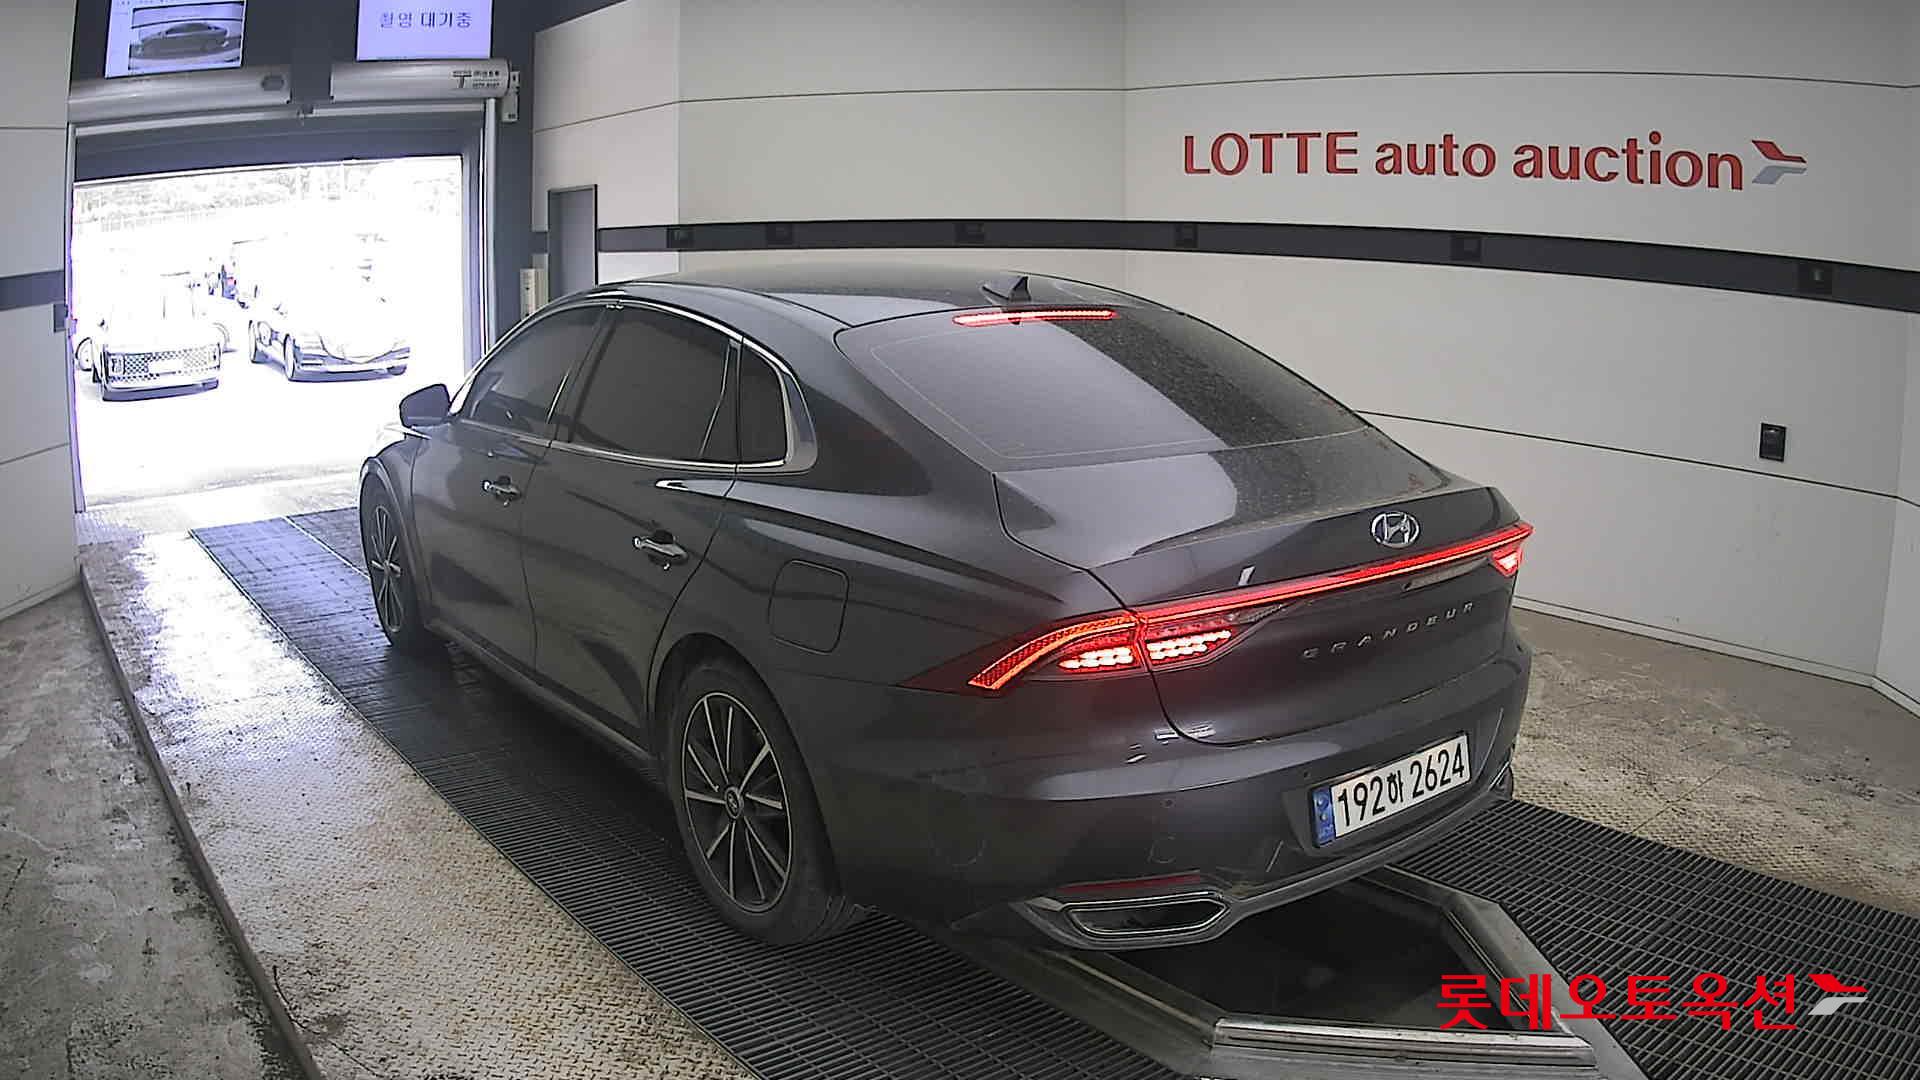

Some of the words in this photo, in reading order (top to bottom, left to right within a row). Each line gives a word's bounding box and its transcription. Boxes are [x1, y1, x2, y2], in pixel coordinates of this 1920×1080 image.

[420, 11, 473, 29] 대기중
[1184, 131, 1358, 176] LOTTE
[1375, 133, 1496, 178] auto
[1513, 131, 1744, 190] auction
[1302, 602, 1473, 659] GRANDEUR
[1338, 770, 1403, 827] 192하
[1410, 743, 1465, 799] 2624
